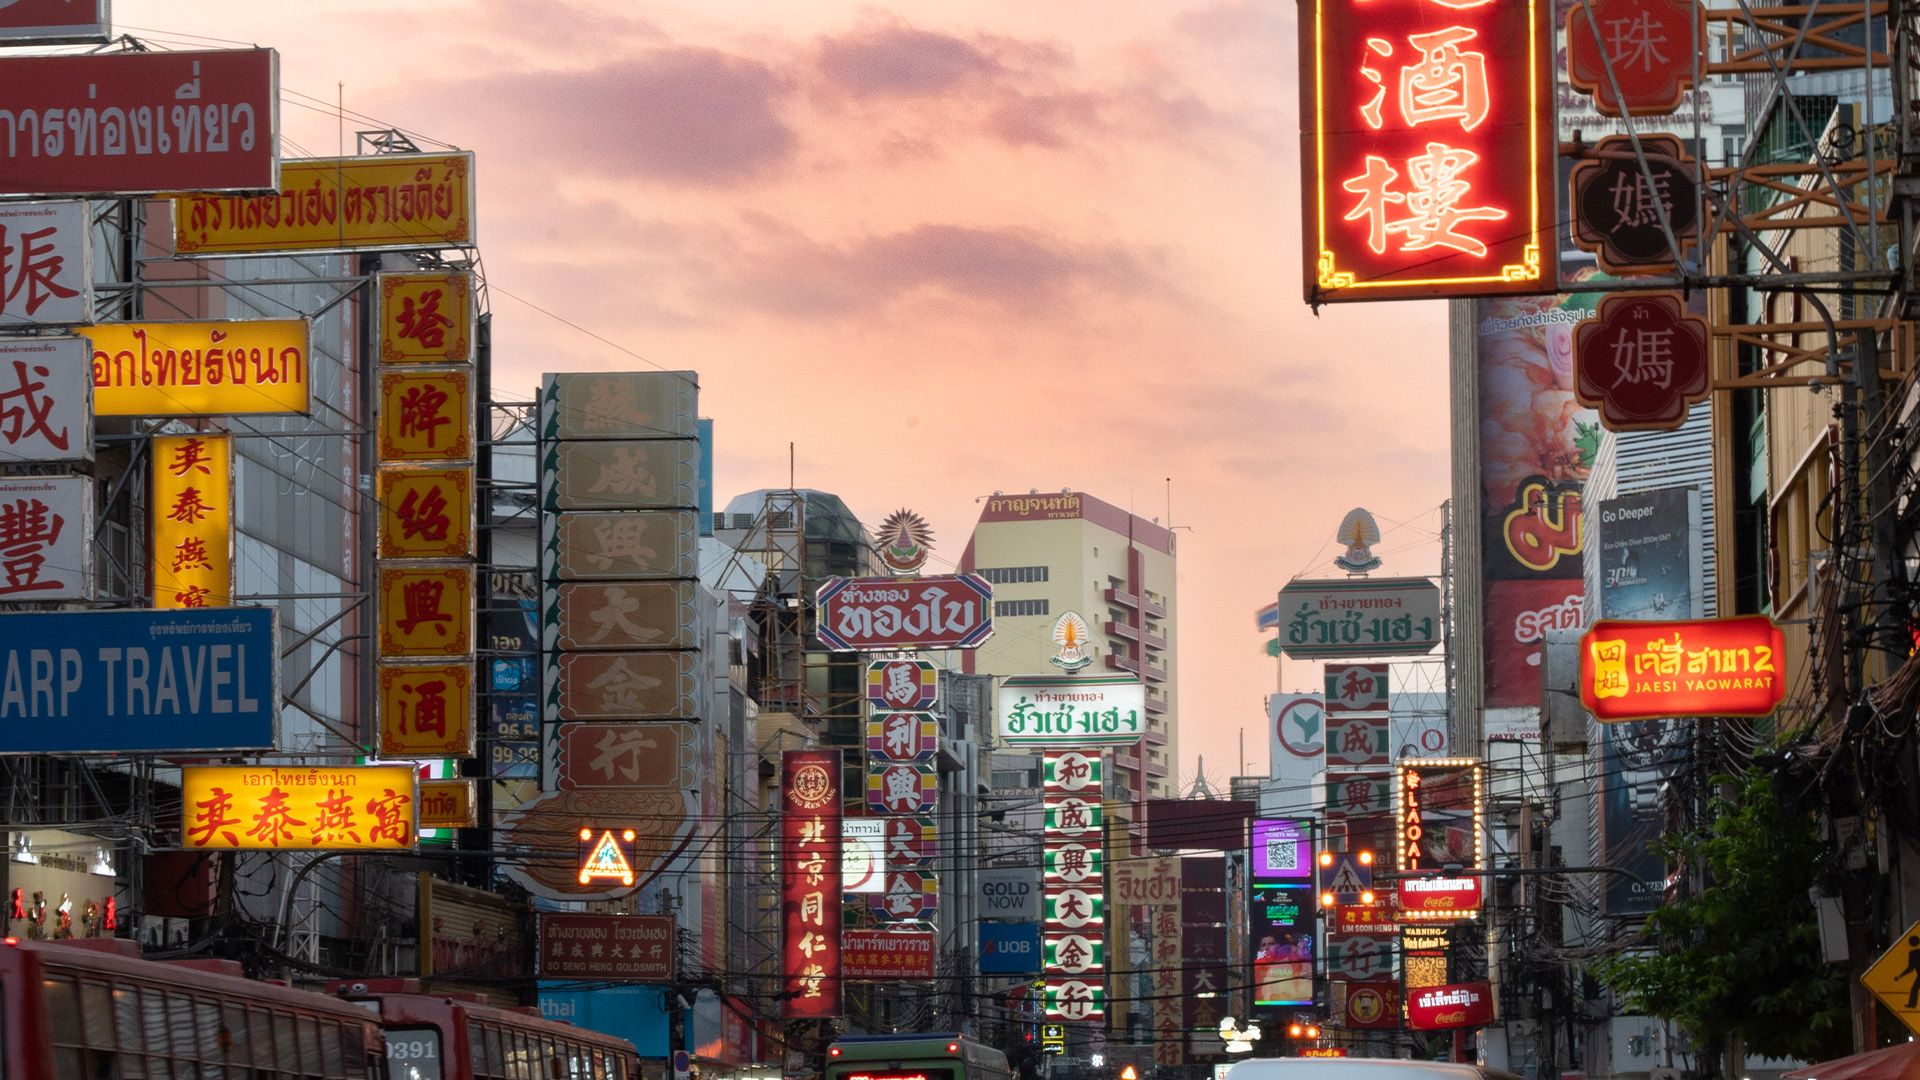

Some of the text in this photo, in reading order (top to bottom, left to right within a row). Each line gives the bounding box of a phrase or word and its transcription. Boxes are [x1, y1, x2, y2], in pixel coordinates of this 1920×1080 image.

[0, 61, 255, 158] การท่องเที่ยว
[1343, 0, 1508, 258] 酒樓
[1602, 506, 1654, 524] Go Deeper
[837, 586, 975, 639] ทองใบ
[0, 643, 259, 718] ARP TRAVEL
[1635, 676, 1773, 693] JAESI YAOWARAT
[885, 665, 924, 931] 馬利興大金
[982, 882, 1030, 896] GOLD
[798, 814, 827, 999] 北京同仁堂
[988, 896, 1024, 909] NOW
[1342, 924, 1355, 933] LIM
[1355, 924, 1373, 933] SOON
[1374, 924, 1392, 932] HENG
[1405, 928, 1442, 936] WARNING
[998, 940, 1031, 954] UOB
[547, 961, 667, 973] SO SENG HENG GOLDSMITH
[540, 997, 577, 1017] thai
